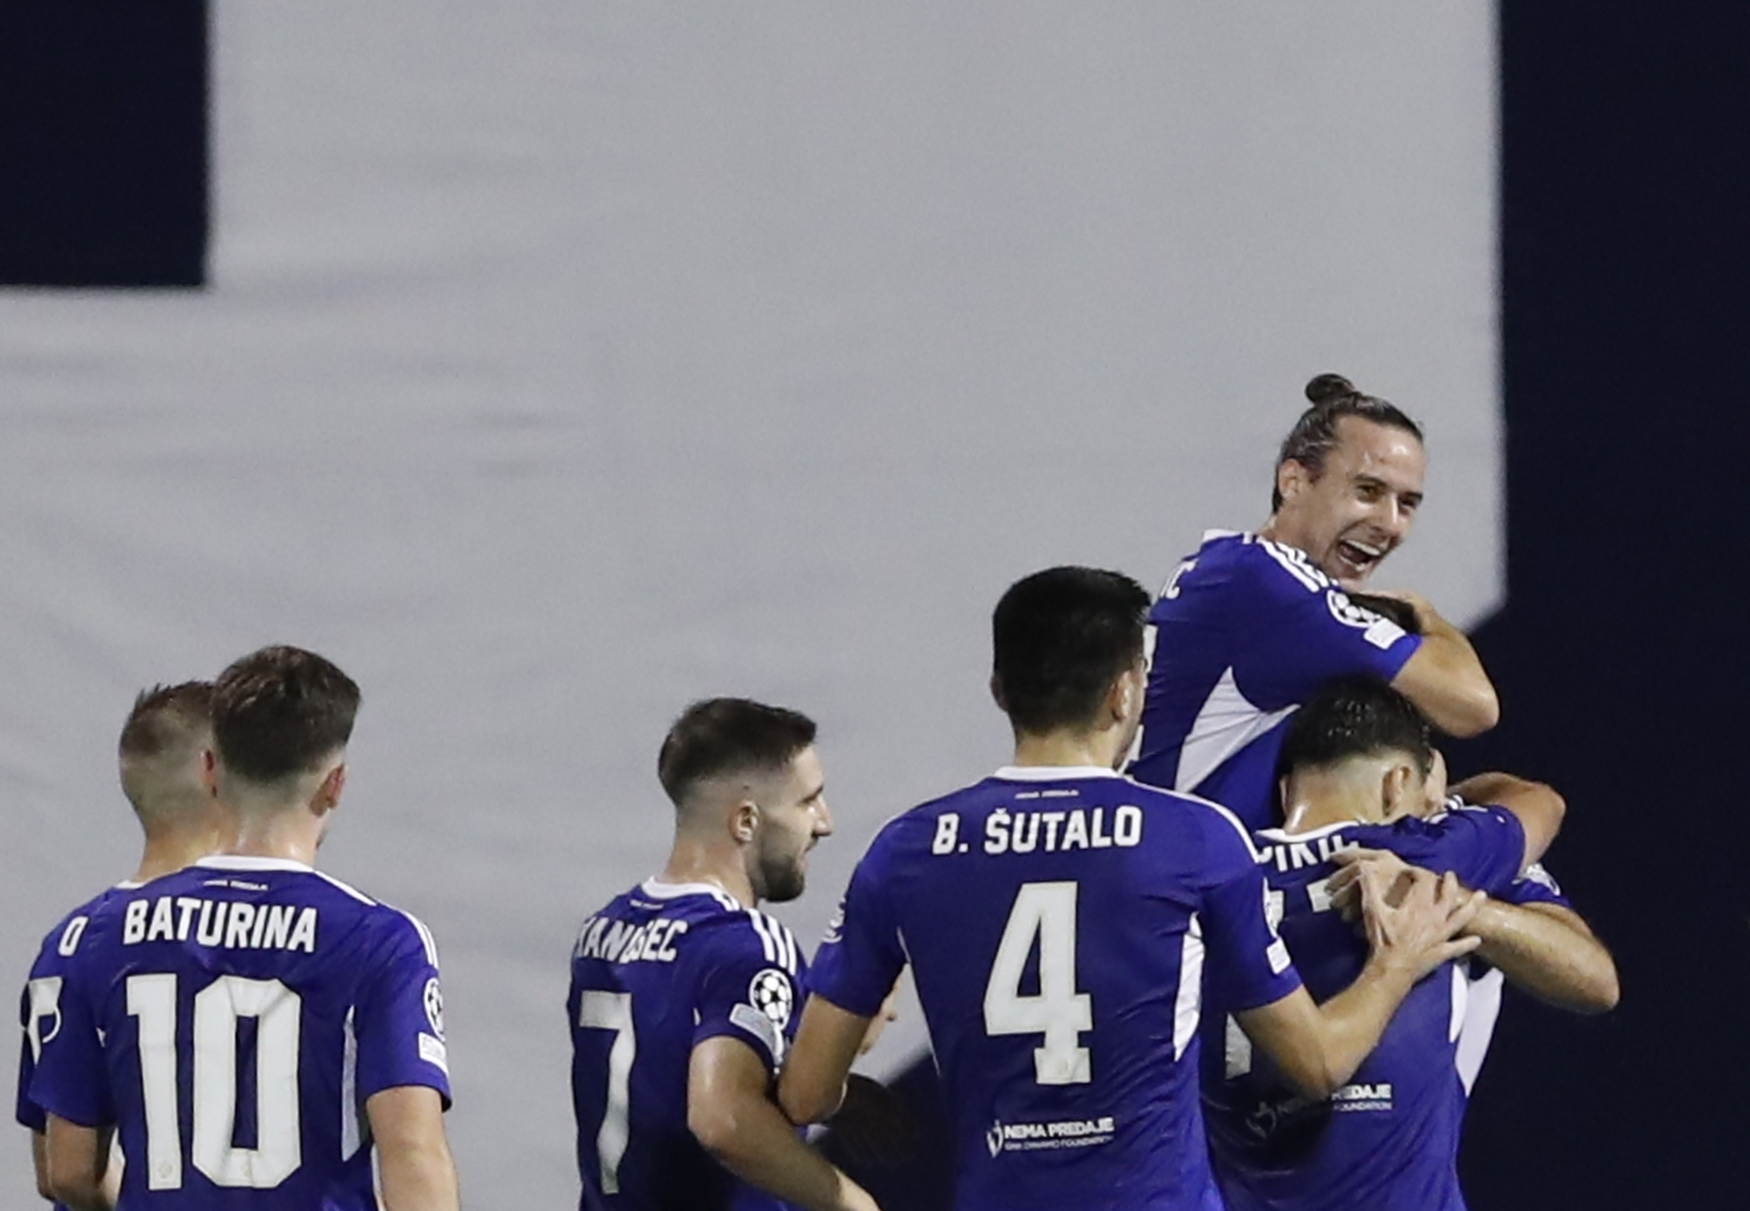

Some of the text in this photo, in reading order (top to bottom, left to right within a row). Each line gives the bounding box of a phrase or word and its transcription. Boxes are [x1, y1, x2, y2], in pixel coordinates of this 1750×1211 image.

[932, 806, 1142, 854] B. ŠUTALO
[123, 896, 317, 953] BATURINA
[983, 881, 1092, 1085] 4
[126, 972, 302, 1190] 10
[579, 990, 636, 1194] 7
[1004, 1117, 1114, 1139] NEMA PREDAJE
